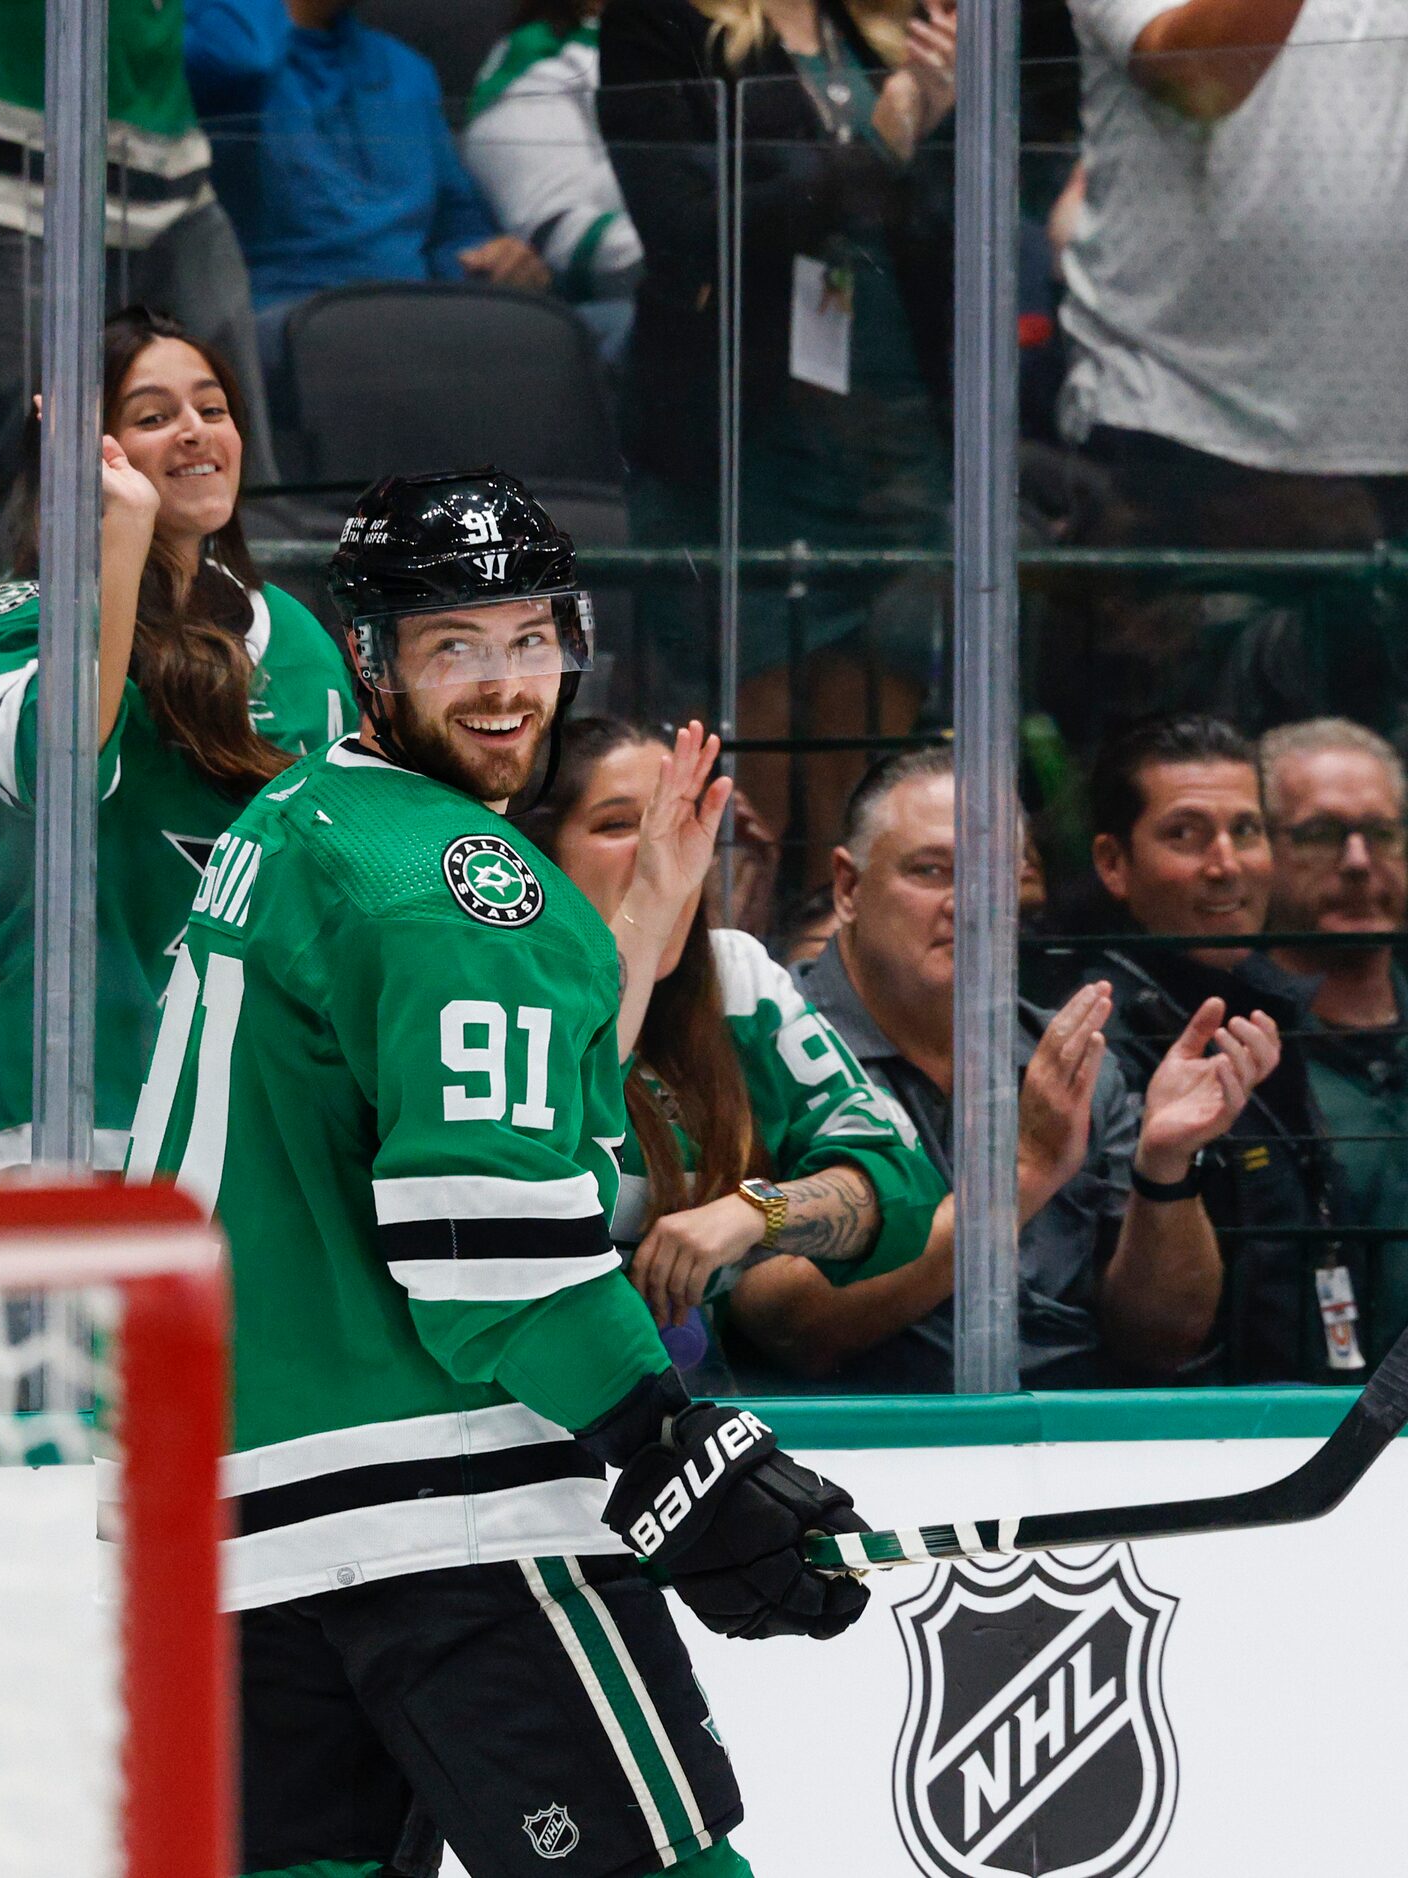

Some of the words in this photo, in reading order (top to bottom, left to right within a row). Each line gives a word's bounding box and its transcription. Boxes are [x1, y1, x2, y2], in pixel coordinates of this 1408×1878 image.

[461, 509, 503, 545] 91
[452, 841, 535, 885] DALLAS
[457, 882, 533, 920] STARS
[440, 999, 556, 1131] 91
[957, 1641, 1117, 1842] NHL
[541, 1817, 564, 1851] NHL
